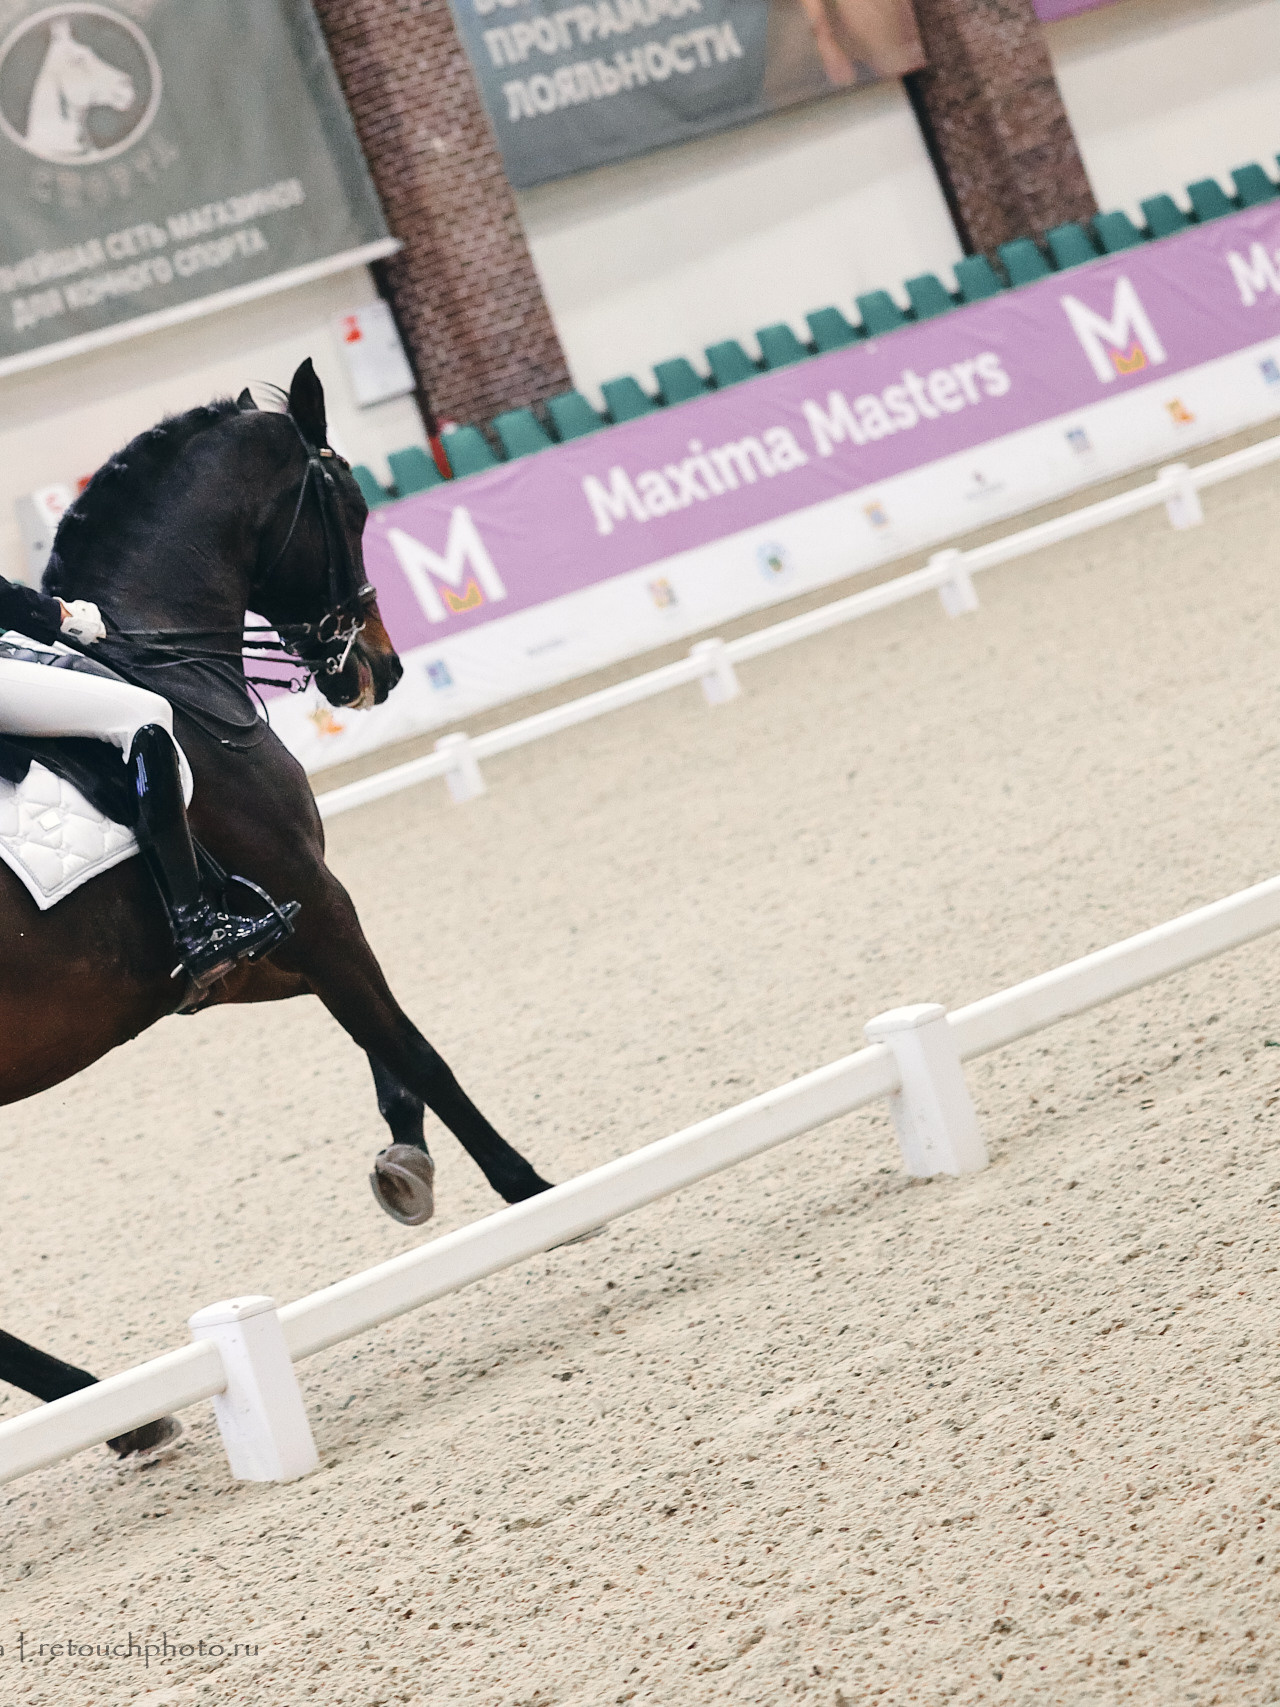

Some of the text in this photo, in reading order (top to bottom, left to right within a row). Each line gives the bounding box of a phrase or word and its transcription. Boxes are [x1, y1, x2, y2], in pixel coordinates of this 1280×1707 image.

[503, 20, 743, 121] ЛОЯЛЬНОСТИ
[105, 221, 168, 260] СЕТЬ
[172, 226, 270, 278] СПОРТА
[581, 350, 1012, 536] Maxima Masters
